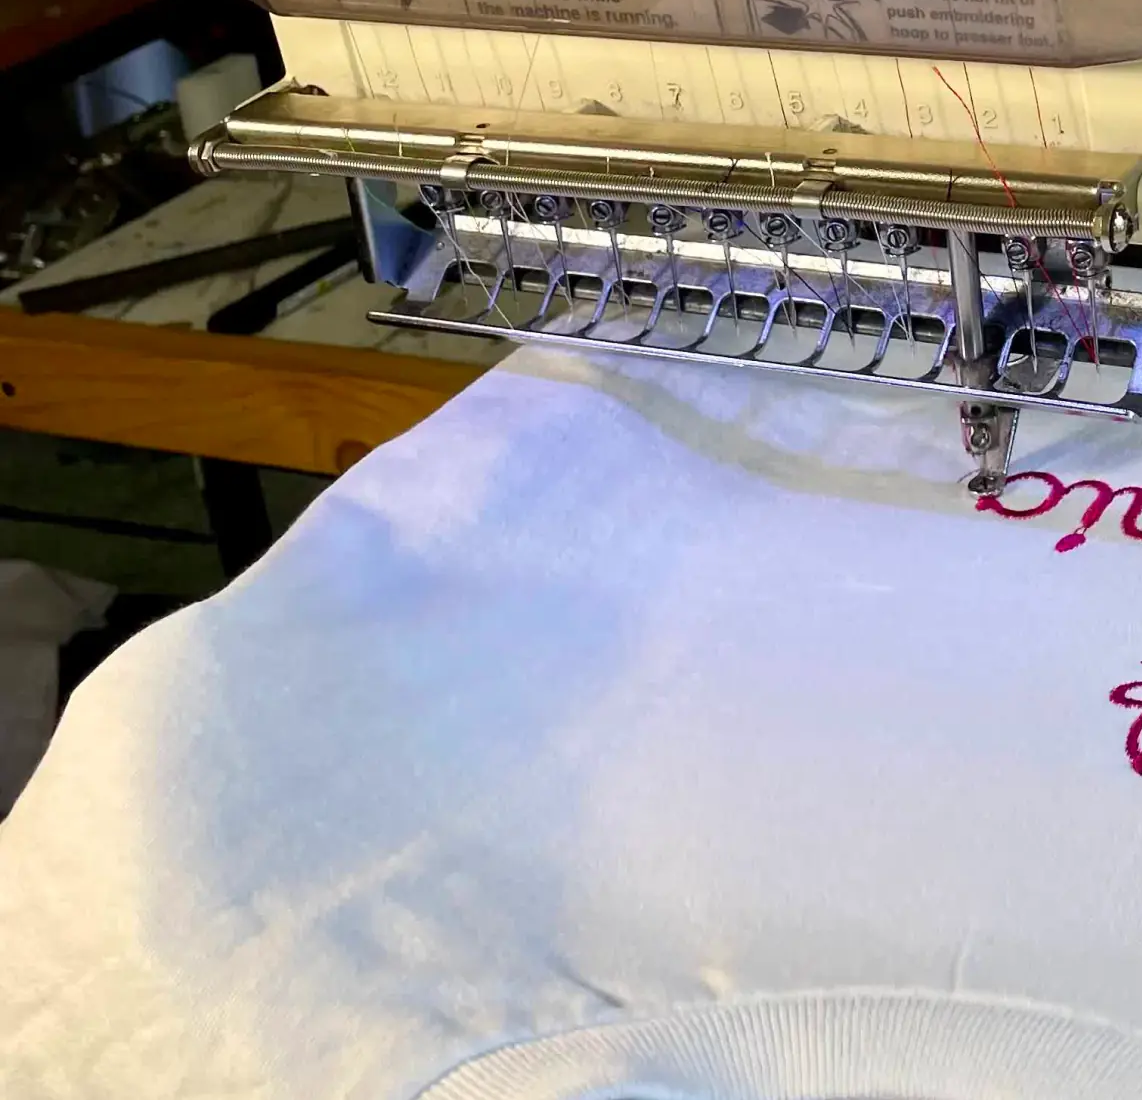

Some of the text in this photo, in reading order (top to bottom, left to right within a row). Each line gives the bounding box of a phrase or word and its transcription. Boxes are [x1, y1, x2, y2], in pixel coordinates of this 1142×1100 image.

[510, 3, 581, 21] machine
[585, 5, 601, 21] is
[887, 5, 926, 21] push
[934, 27, 950, 41] to
[548, 79, 564, 100] 9
[666, 82, 683, 106] 7
[788, 90, 805, 115] 5
[854, 98, 869, 119] 4
[916, 104, 934, 126] 3
[982, 107, 999, 130] 2
[1051, 112, 1066, 135] 1
